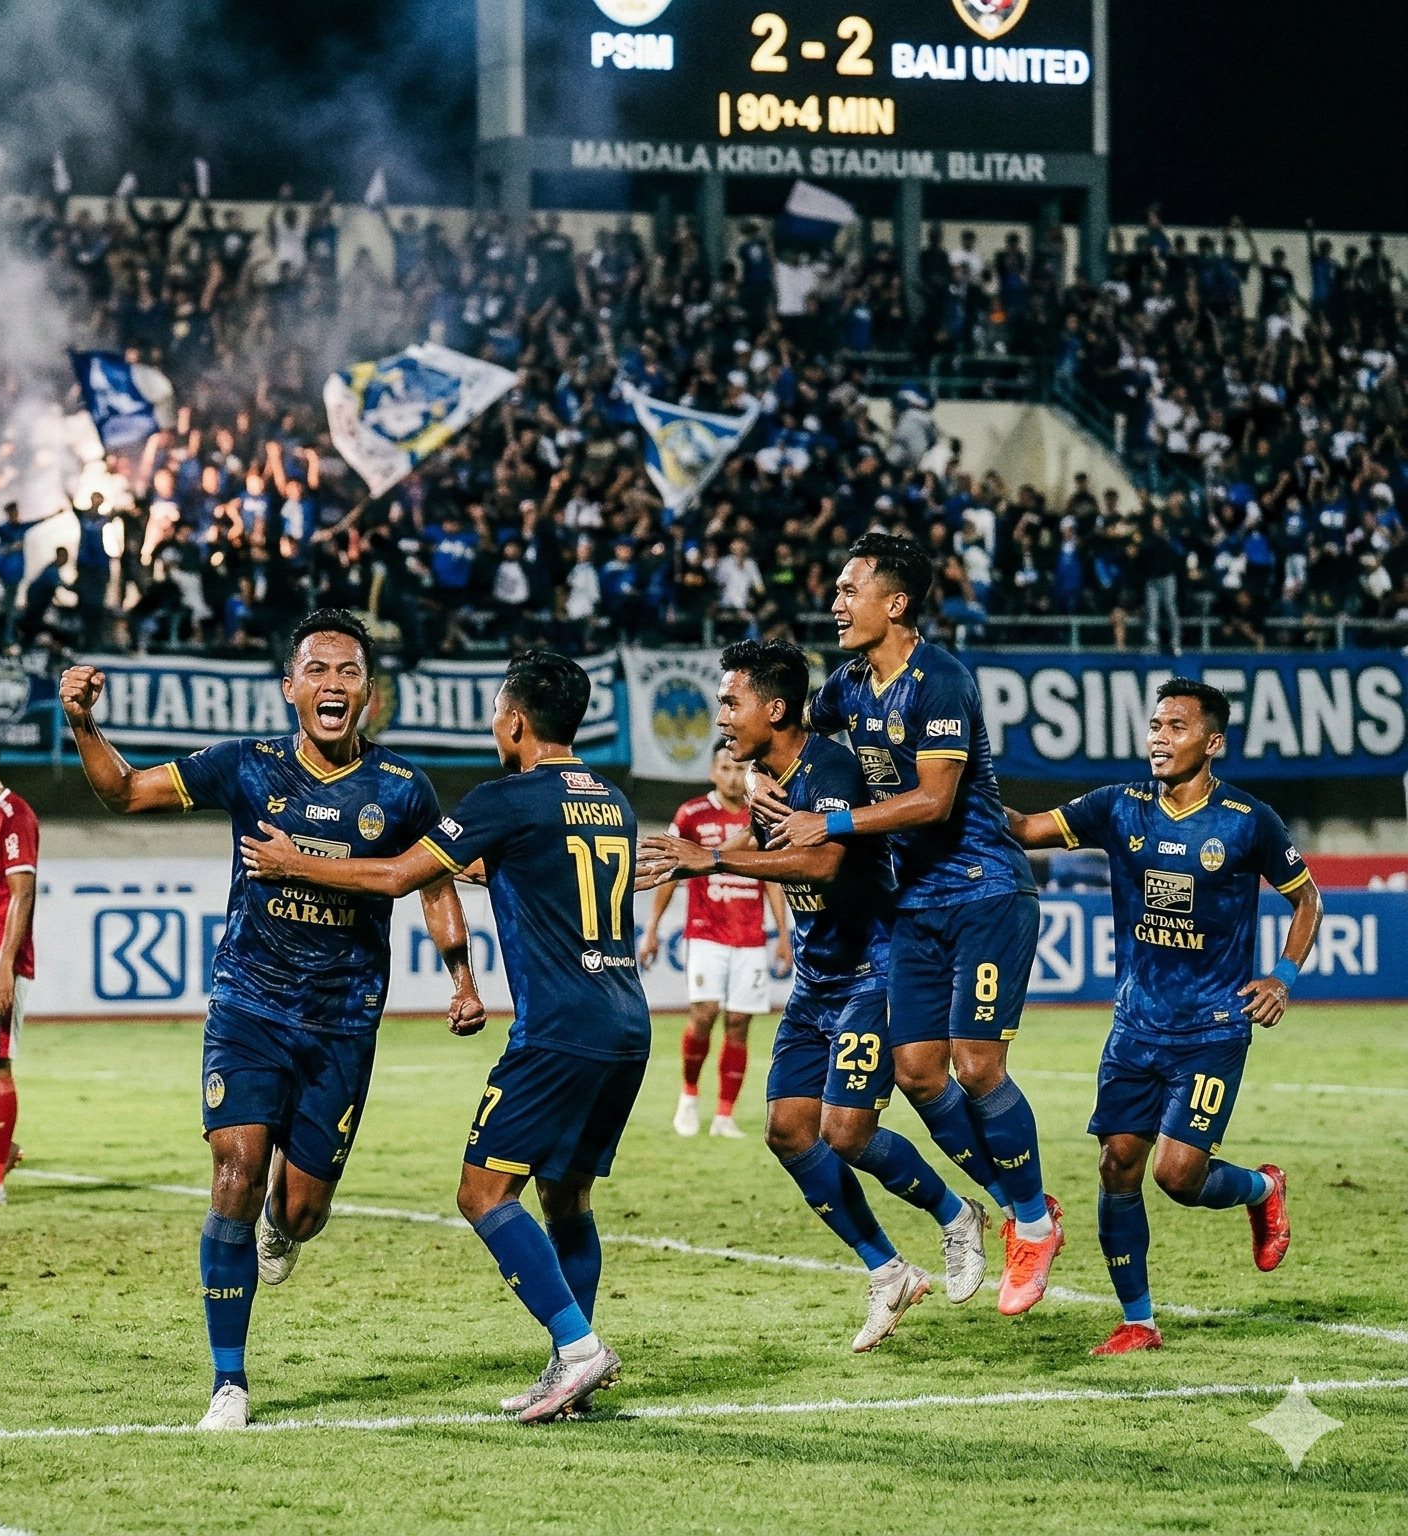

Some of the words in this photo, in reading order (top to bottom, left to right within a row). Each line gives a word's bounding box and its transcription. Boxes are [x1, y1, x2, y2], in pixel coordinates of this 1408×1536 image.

[592, 32, 674, 71] PSIM
[749, 12, 789, 73] 2
[835, 15, 875, 77] 2
[892, 43, 966, 82] BALI
[972, 46, 1090, 85] UNITED
[737, 94, 823, 133] 90+4
[828, 96, 895, 135] MIN
[571, 140, 712, 173] MANDALA
[717, 144, 801, 174] KRIDA
[810, 146, 941, 180] STADIUM,
[947, 150, 1046, 182] BLITAR
[561, 801, 624, 827] IKHSAN
[282, 886, 349, 907] GUDANG
[566, 836, 631, 941] 17
[267, 898, 356, 927] GARAM
[1143, 913, 1195, 931] GUDANG
[1134, 924, 1206, 951] GARAM
[975, 962, 999, 1003] 8
[835, 1032, 882, 1072] 23
[1189, 1073, 1227, 1115] 10
[337, 1104, 355, 1143] 4
[202, 1286, 244, 1299] PSIM
